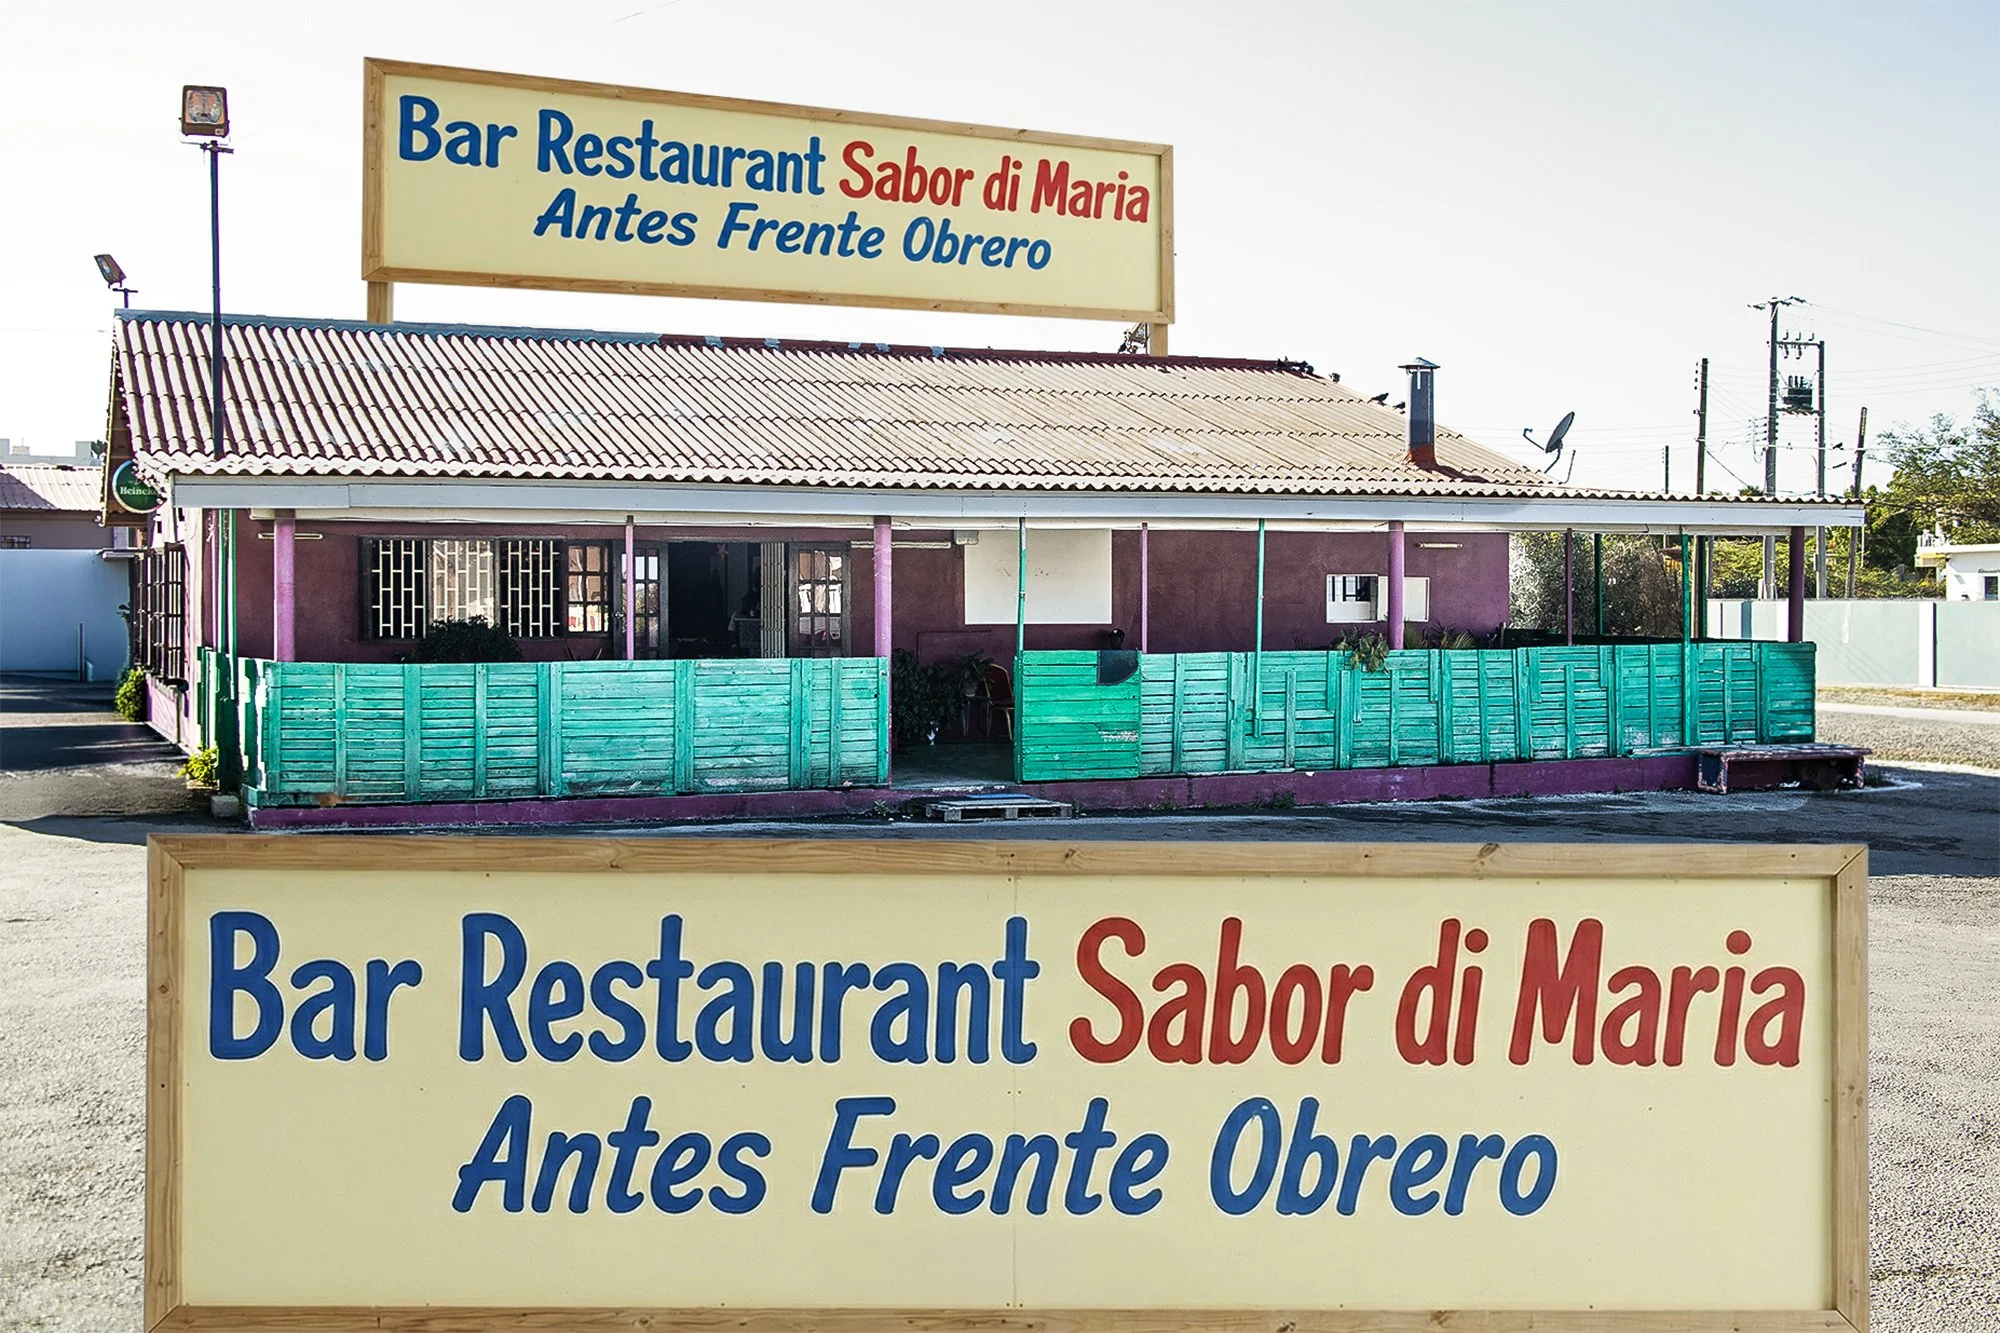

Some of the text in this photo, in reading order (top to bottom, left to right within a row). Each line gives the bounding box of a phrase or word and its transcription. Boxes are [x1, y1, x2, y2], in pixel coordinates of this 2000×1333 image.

[399, 95, 1151, 223] Bar Restaurant Sabor di Maria
[534, 188, 1052, 270] Antes Frente Obrero
[210, 911, 1806, 1067] Bar Restaurant Sabor di Maria
[452, 1095, 1558, 1217] Antes Frente Obrero
